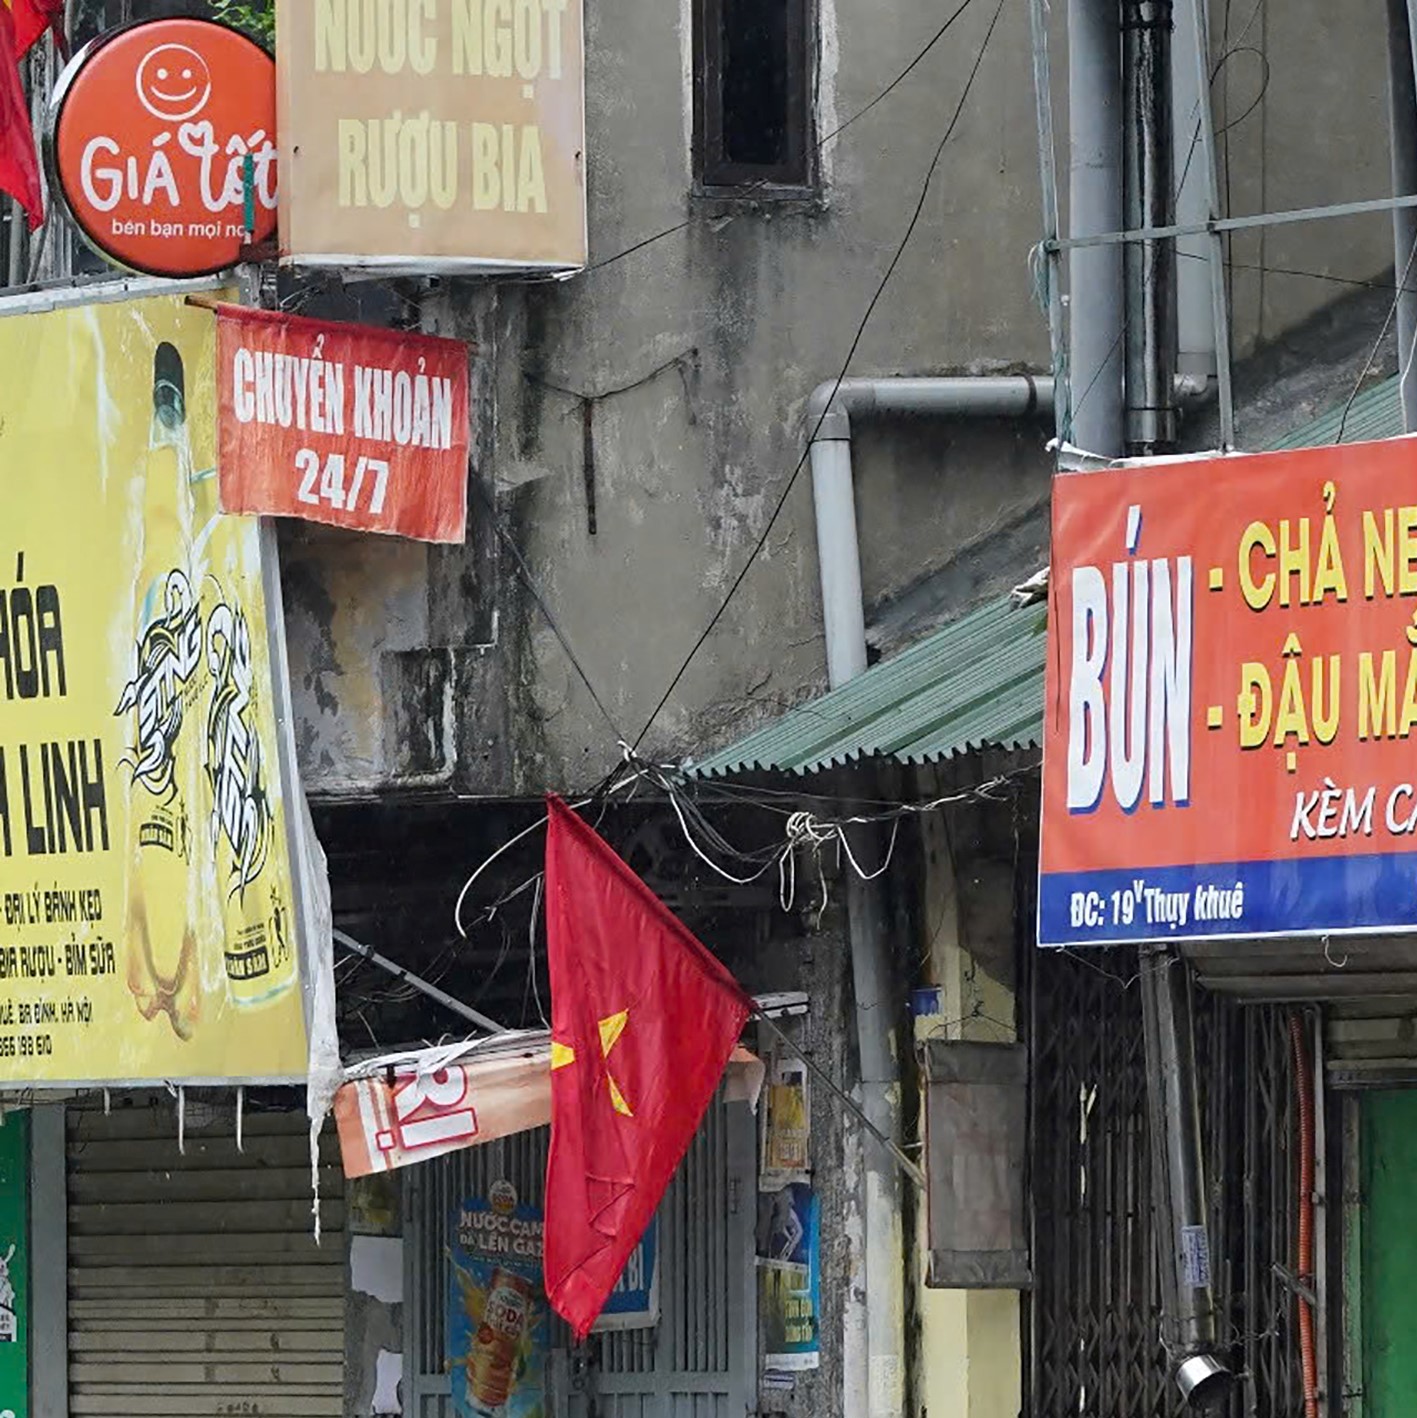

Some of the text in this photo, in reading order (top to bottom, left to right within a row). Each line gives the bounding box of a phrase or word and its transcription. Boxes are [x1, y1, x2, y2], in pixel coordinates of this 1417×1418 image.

[338, 112, 548, 228] RƯỢU BIA
[151, 219, 183, 238] bạn
[189, 220, 220, 239] mọi
[233, 335, 452, 450] CHUYỂN KHOẢN
[295, 452, 389, 515] 24/7
[1239, 481, 1347, 610] CHẢ
[1067, 505, 1192, 812] BÚN
[1238, 632, 1341, 772] ĐẬU
[20, 739, 110, 855] LINH
[1290, 776, 1376, 841] KÈM
[27, 881, 41, 924] LÝ
[44, 880, 77, 923] BÁNH
[79, 889, 102, 929] KẸO
[1070, 891, 1104, 928] ĐC:
[1194, 885, 1244, 920] khuê
